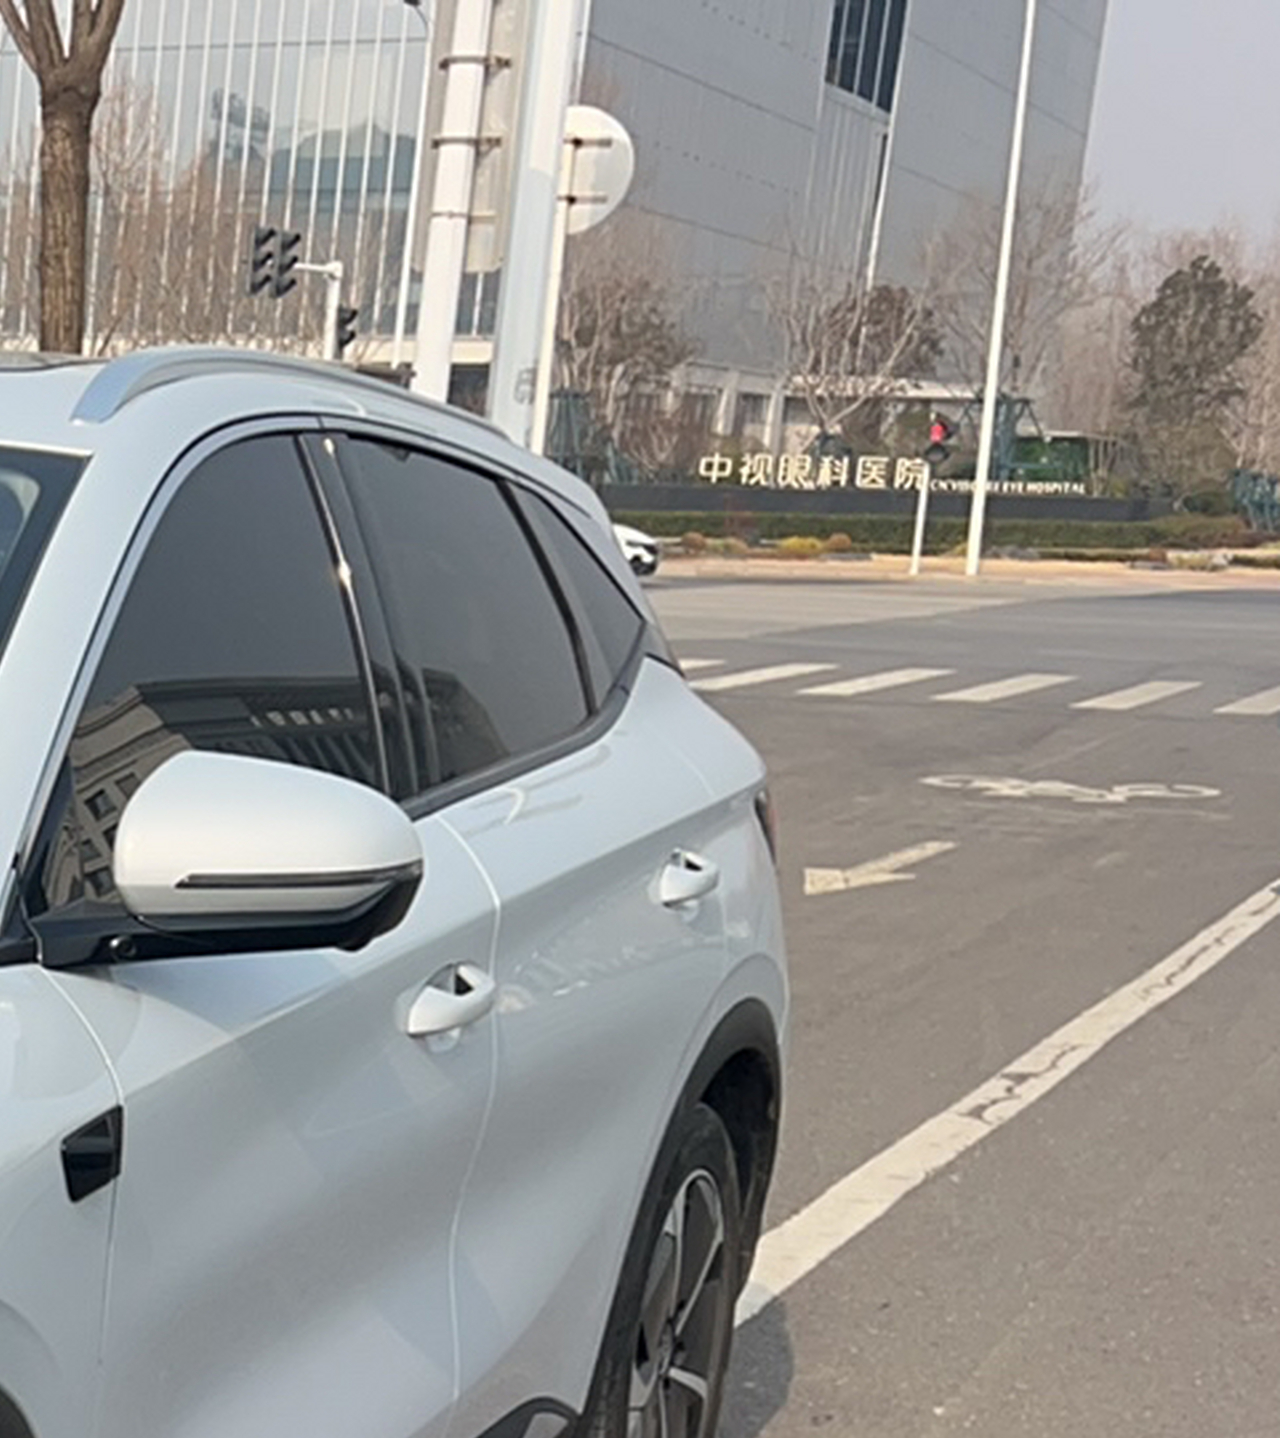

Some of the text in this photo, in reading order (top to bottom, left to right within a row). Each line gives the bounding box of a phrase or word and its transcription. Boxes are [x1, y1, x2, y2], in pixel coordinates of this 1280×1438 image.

[699, 452, 928, 490] 中视眼科医院
[1026, 481, 1086, 495] HOSPITAL
